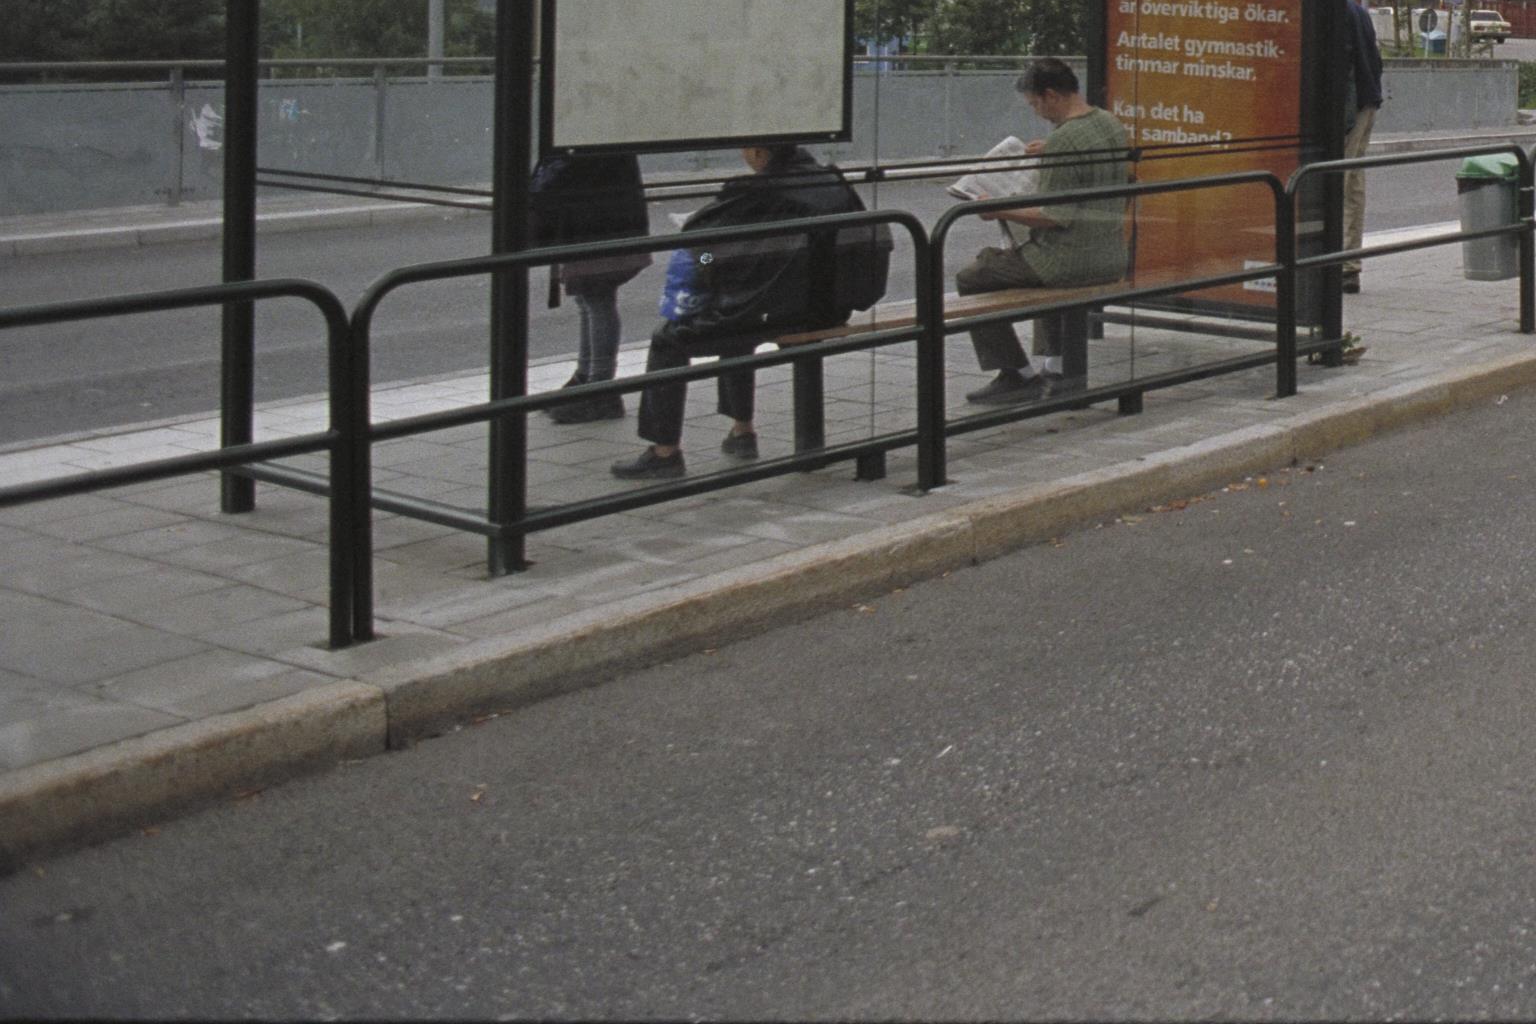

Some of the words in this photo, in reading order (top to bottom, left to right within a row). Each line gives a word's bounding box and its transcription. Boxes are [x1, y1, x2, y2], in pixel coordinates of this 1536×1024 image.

[1244, 4, 1290, 24] ökar.
[1117, 31, 1180, 52] Antalet
[1184, 36, 1284, 59] gymnastik-
[1116, 54, 1178, 74] timmar
[1184, 60, 1257, 82] minskar.
[1113, 100, 1146, 118] Kan
[1151, 102, 1179, 120] det
[1184, 105, 1204, 124] ha
